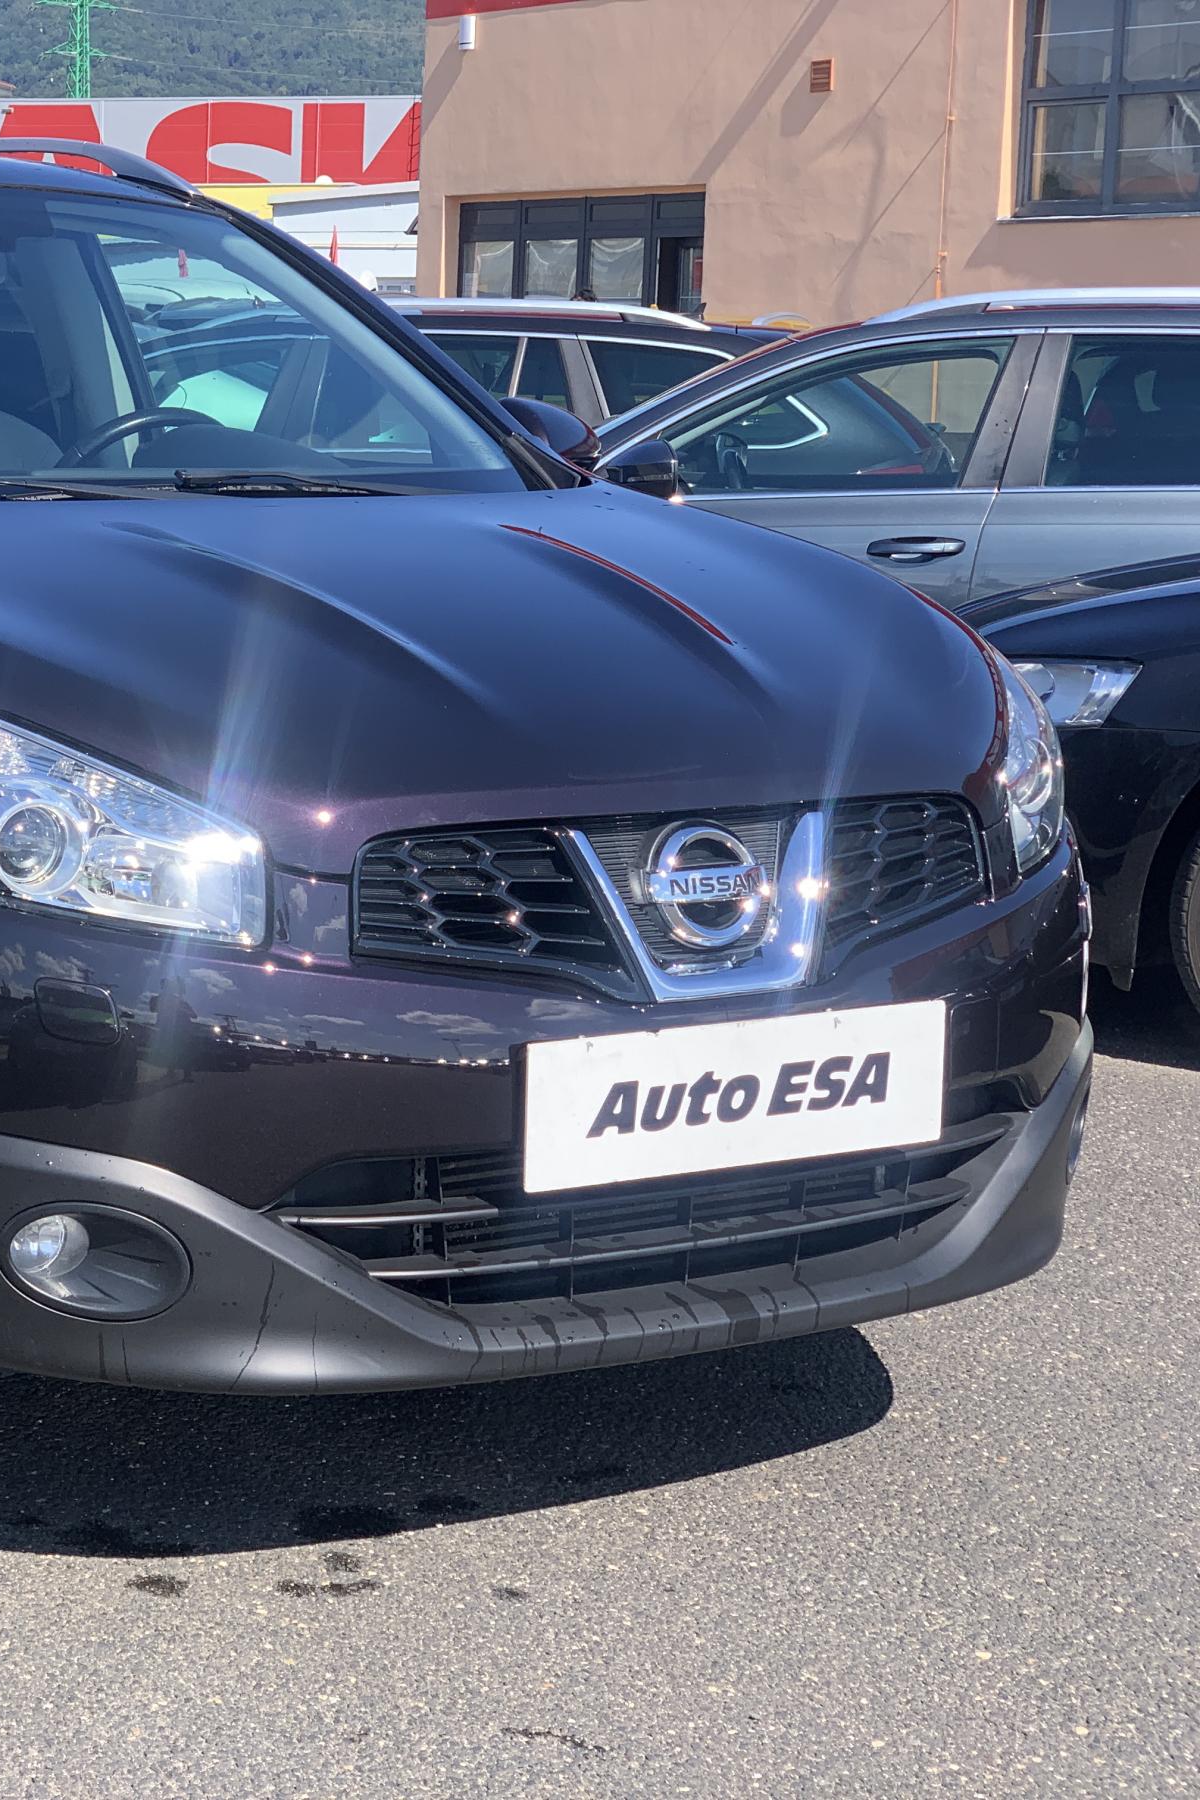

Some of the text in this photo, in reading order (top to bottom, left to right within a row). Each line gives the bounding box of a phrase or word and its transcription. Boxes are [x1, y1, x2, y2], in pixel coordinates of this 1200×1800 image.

[669, 871, 761, 896] NISSAN
[586, 1051, 890, 1138] Auto ESA
